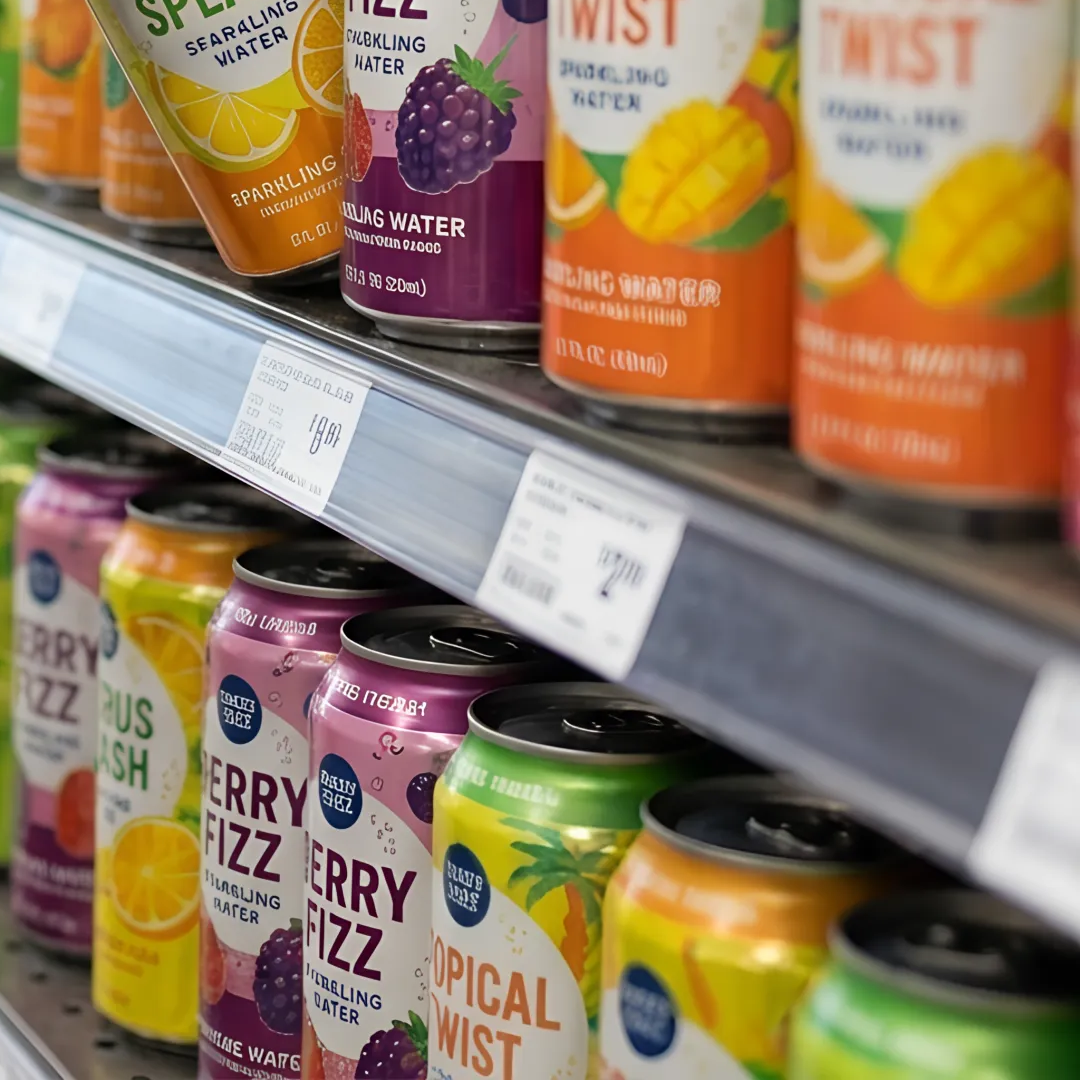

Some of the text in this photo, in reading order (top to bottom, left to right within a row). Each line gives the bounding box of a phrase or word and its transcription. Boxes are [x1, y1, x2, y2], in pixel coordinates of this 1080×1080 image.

[389, 211, 466, 238] WATER
[204, 752, 307, 828] ERRY
[206, 809, 281, 883] FIZZ
[306, 831, 417, 923] ERRY
[306, 899, 381, 981] FIZZ
[431, 930, 561, 1032] OPICAL
[432, 992, 522, 1080] WIST
